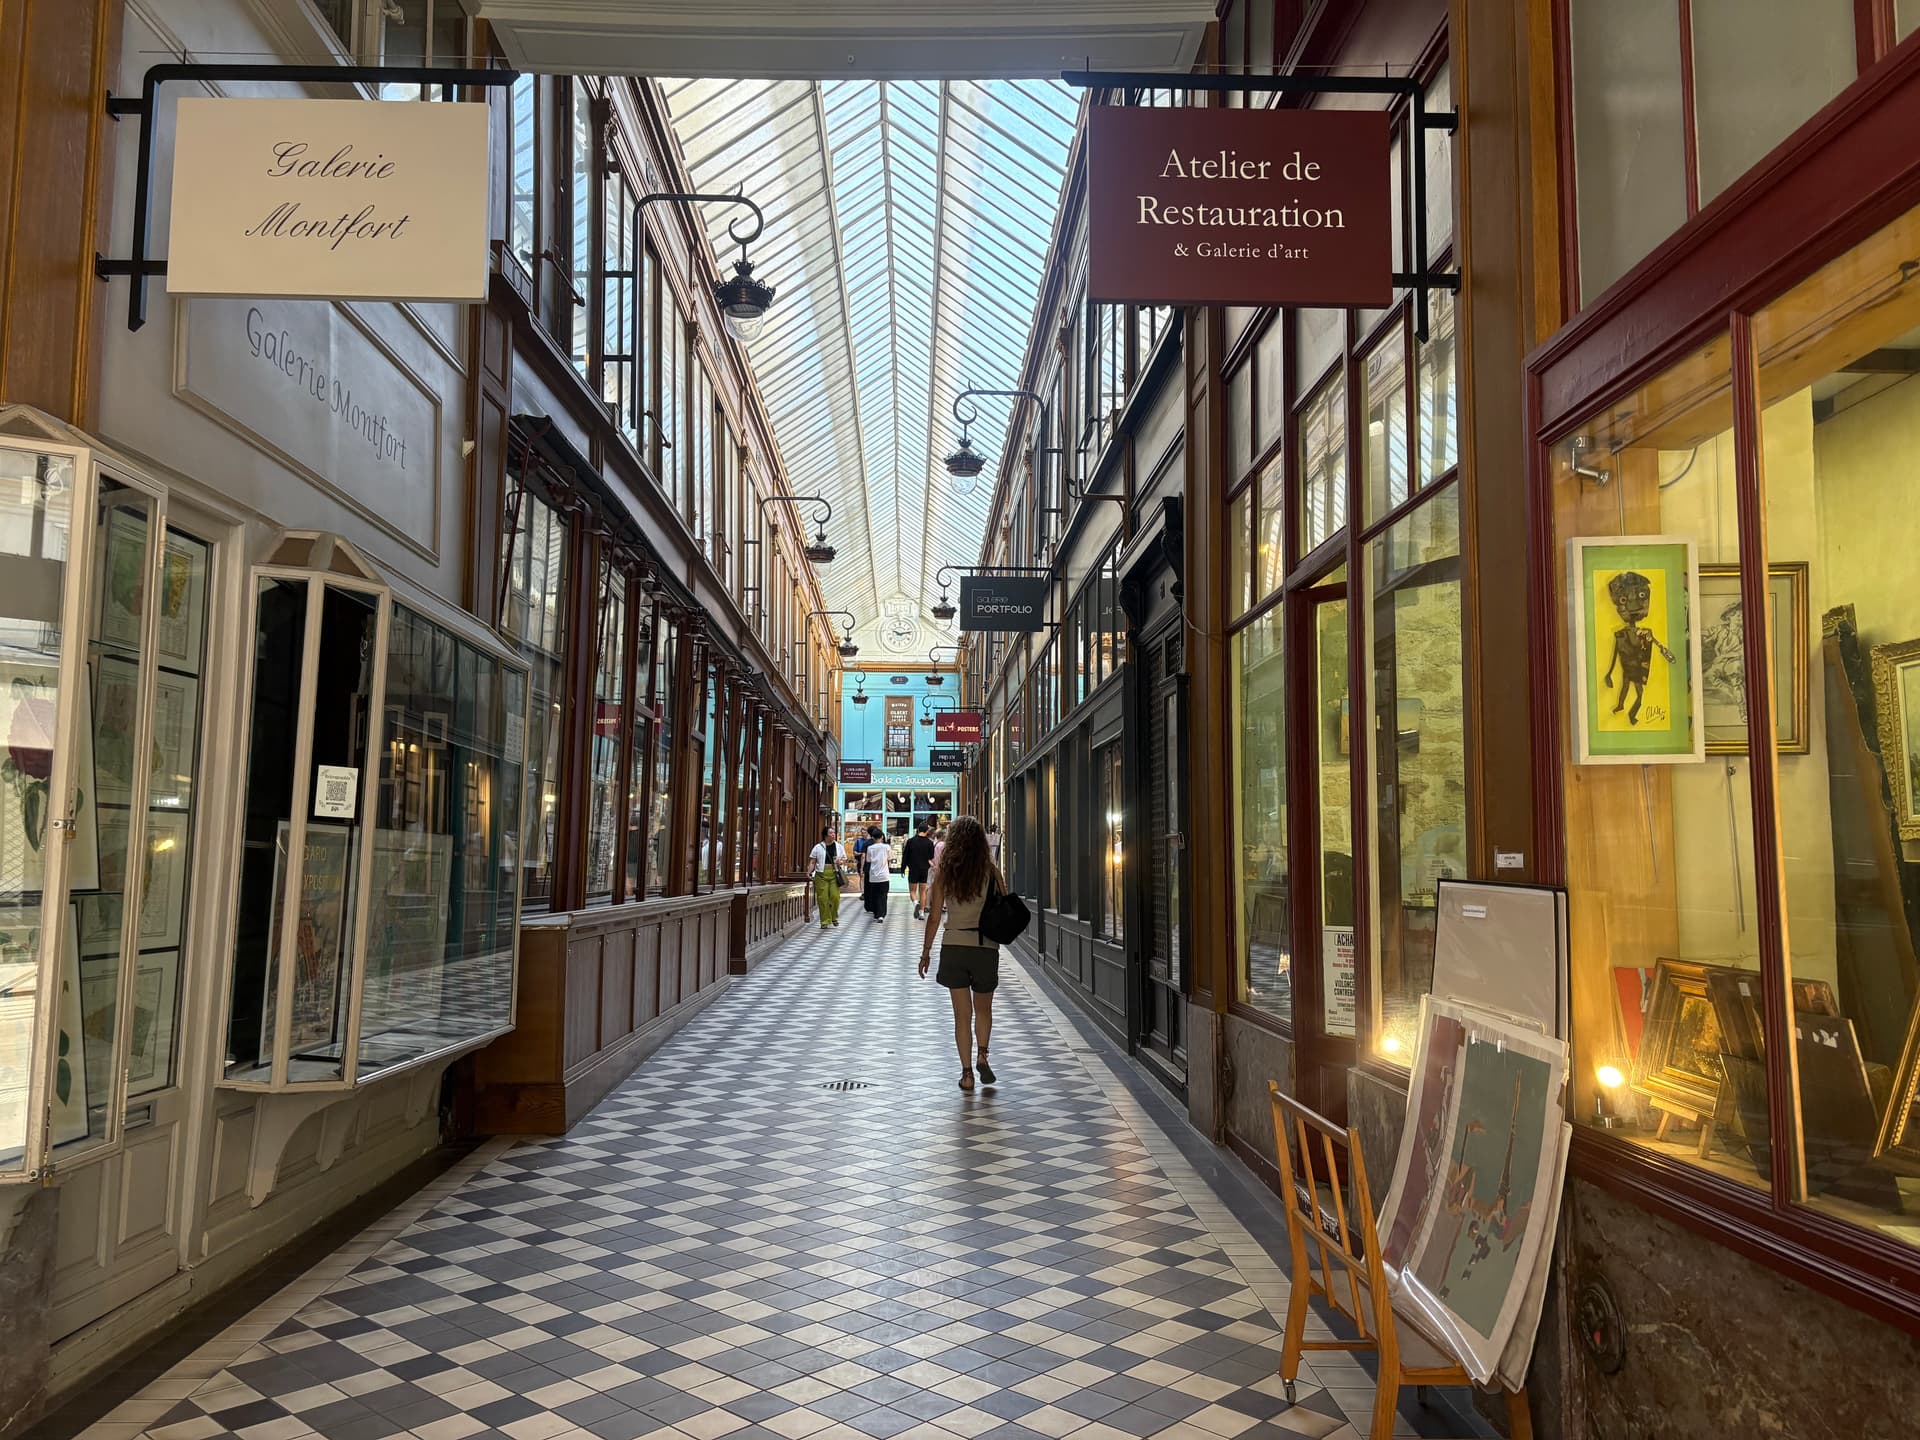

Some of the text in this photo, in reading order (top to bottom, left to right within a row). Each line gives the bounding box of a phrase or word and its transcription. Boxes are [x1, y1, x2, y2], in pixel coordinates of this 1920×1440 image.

[267, 141, 396, 179] Galerie
[1159, 148, 1321, 181] Atelier de
[244, 202, 411, 251] Montfort
[1136, 195, 1345, 228] Restauration
[1174, 242, 1190, 257] &
[1197, 242, 1261, 258] Galerie
[246, 307, 407, 470] Galerie Montfort
[976, 605, 1033, 614] PORTFOLIO
[304, 845, 327, 861] GARO
[1338, 933, 1354, 946] ACHA
